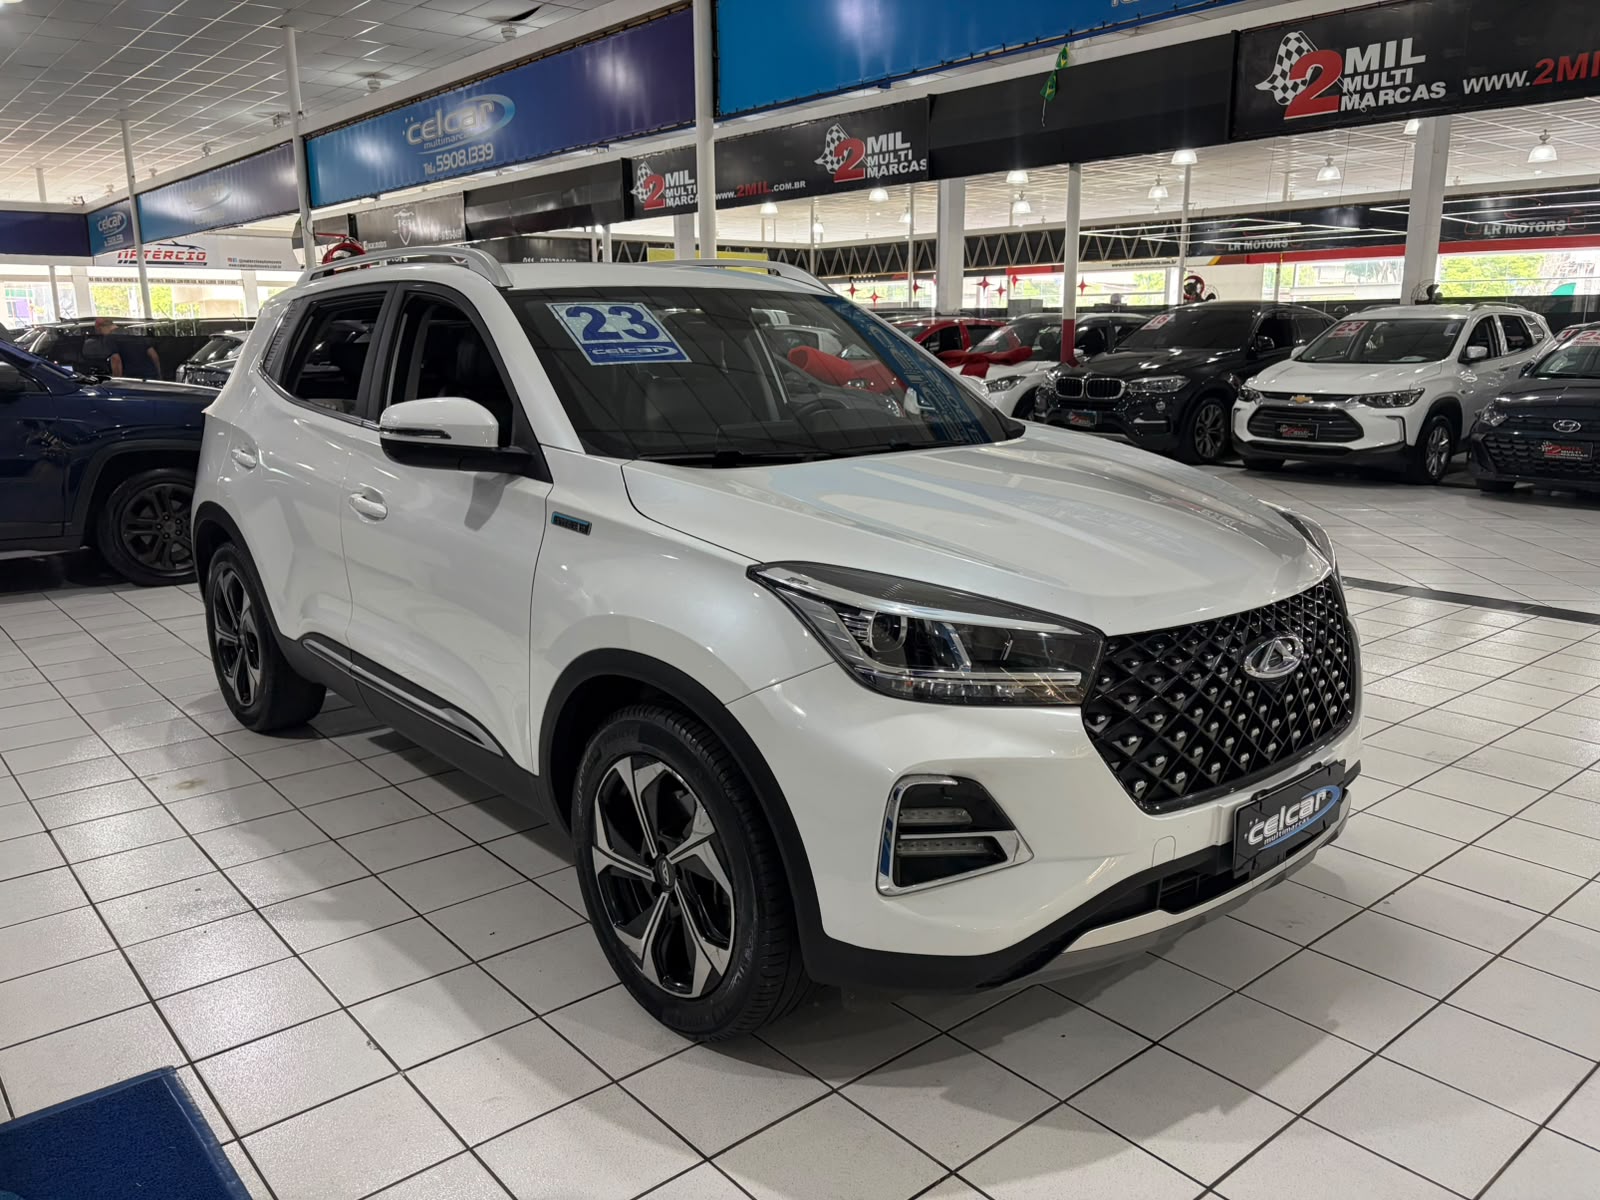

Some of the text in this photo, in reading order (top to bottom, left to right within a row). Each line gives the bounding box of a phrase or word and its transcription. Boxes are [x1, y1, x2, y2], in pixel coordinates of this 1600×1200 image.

[1344, 37, 1427, 75] MIL
[1342, 67, 1414, 94] MULTI
[1340, 81, 1447, 112] MARCAS
[406, 101, 494, 145] celcar
[866, 131, 911, 155] MIL
[436, 142, 494, 172] 5908.1339
[866, 149, 913, 167] MULTI
[665, 170, 695, 188] MIL
[866, 158, 928, 179] MARCAS
[666, 184, 696, 199] MULTI
[666, 194, 699, 208] MARC
[1483, 219, 1567, 236] LR MOTORS
[1243, 237, 1289, 250] MOTORS
[565, 305, 660, 341] 23
[591, 345, 665, 356] celcar
[1248, 789, 1327, 846] celcar
